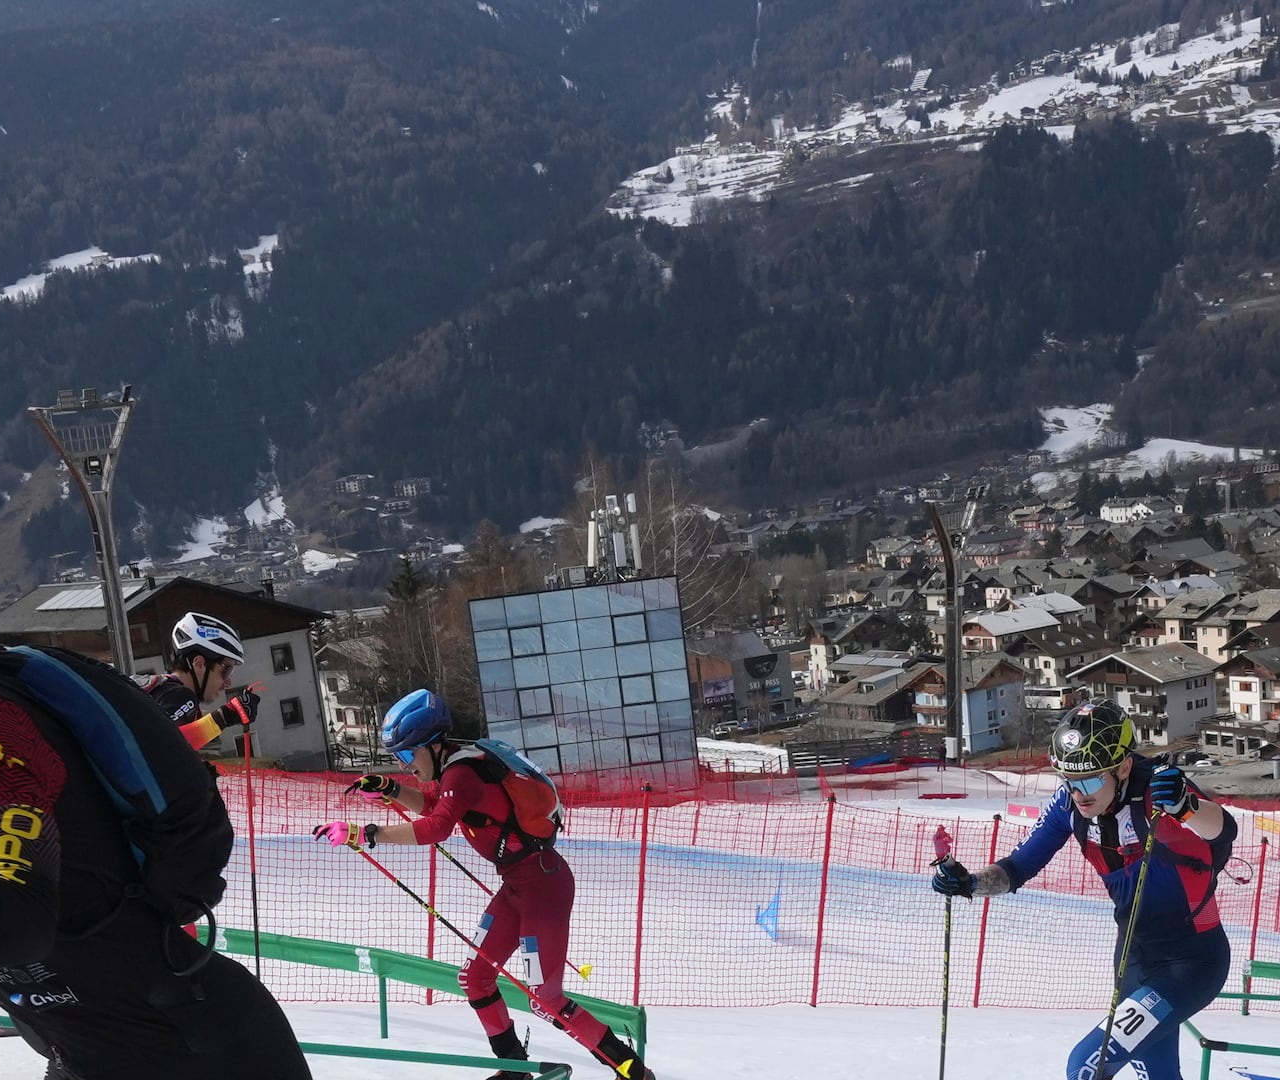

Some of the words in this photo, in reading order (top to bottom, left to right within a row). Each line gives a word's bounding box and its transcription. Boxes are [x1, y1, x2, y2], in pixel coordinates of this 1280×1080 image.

[749, 682, 760, 690] SKI
[766, 678, 780, 686] PASS
[1114, 1007, 1145, 1037] 20
